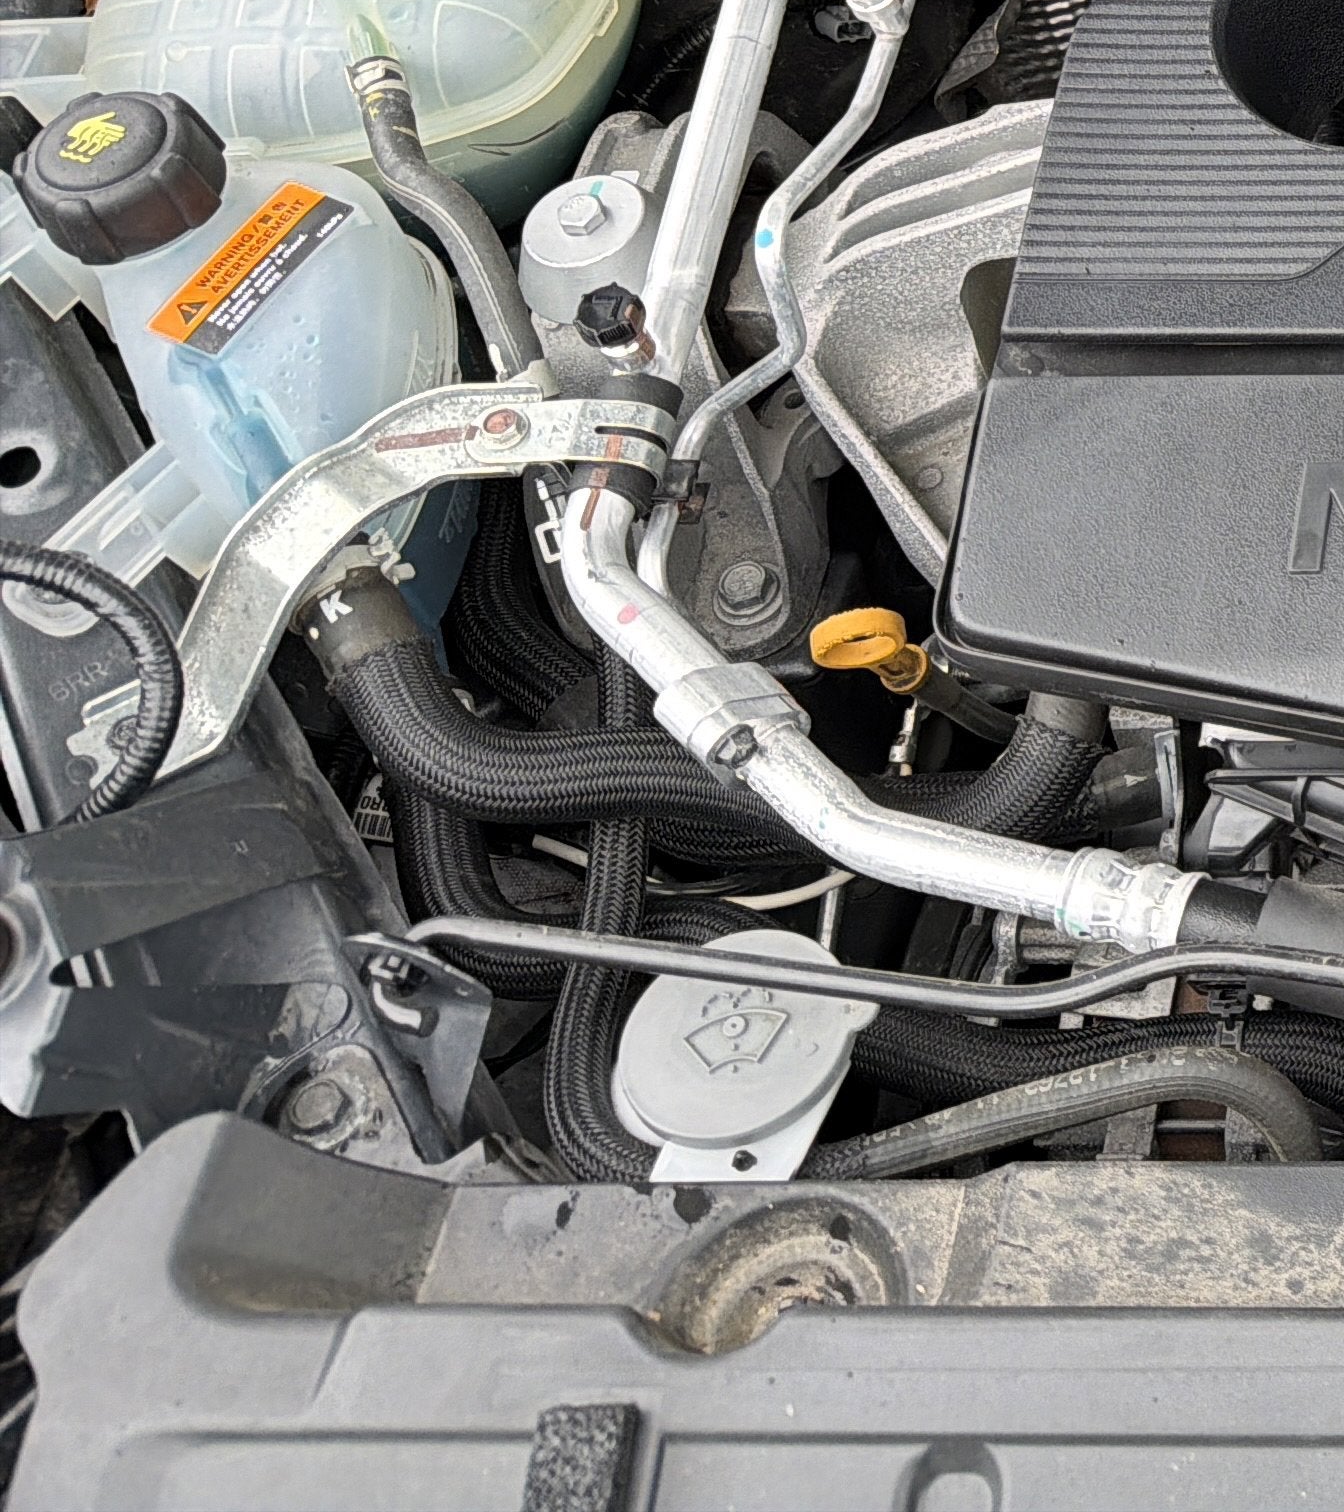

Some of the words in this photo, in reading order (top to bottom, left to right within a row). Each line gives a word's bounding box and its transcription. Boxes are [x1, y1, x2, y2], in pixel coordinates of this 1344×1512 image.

[194, 232, 255, 288] WARNING
[208, 198, 306, 293] AVERTISSEMENT
[318, 588, 354, 625] K
